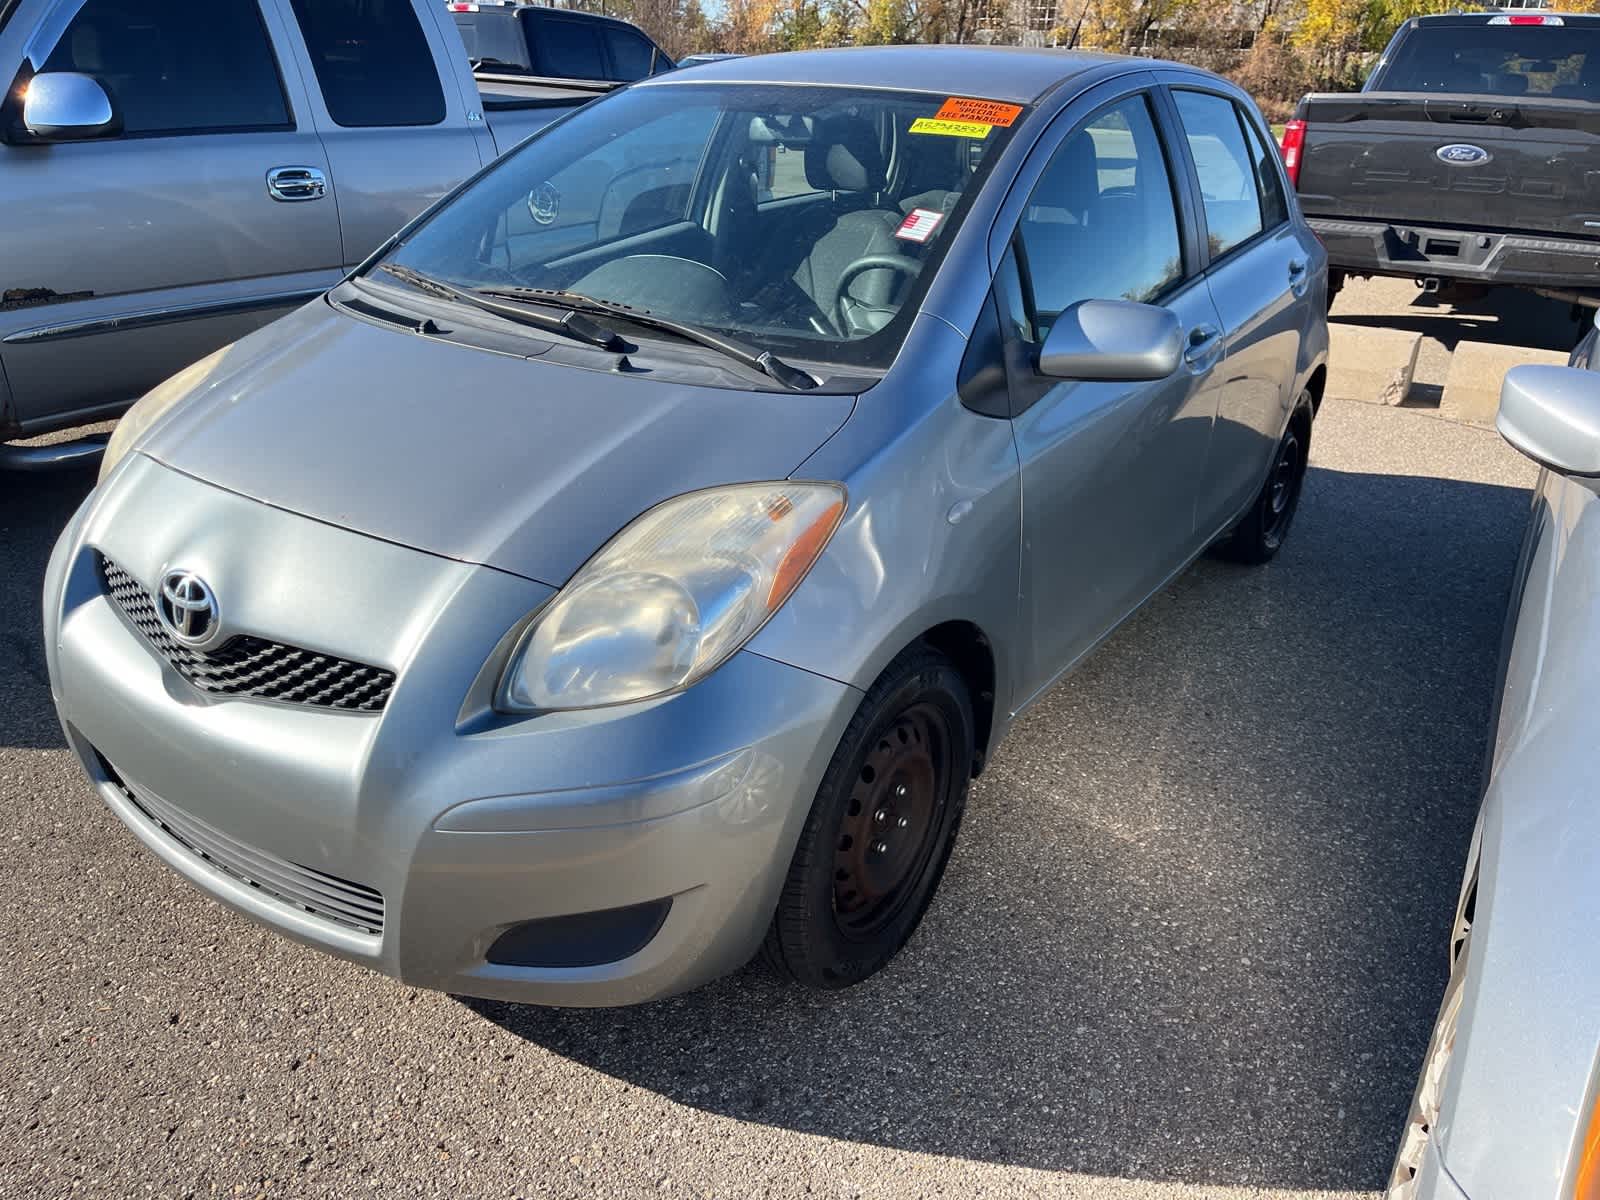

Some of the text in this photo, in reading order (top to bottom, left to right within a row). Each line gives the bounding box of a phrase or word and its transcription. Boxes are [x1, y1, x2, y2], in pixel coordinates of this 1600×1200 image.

[955, 100, 1010, 112] MECHANICS
[959, 107, 998, 117] SPECIAL
[959, 113, 1009, 124] MANAGER
[1447, 146, 1475, 160] Ford
